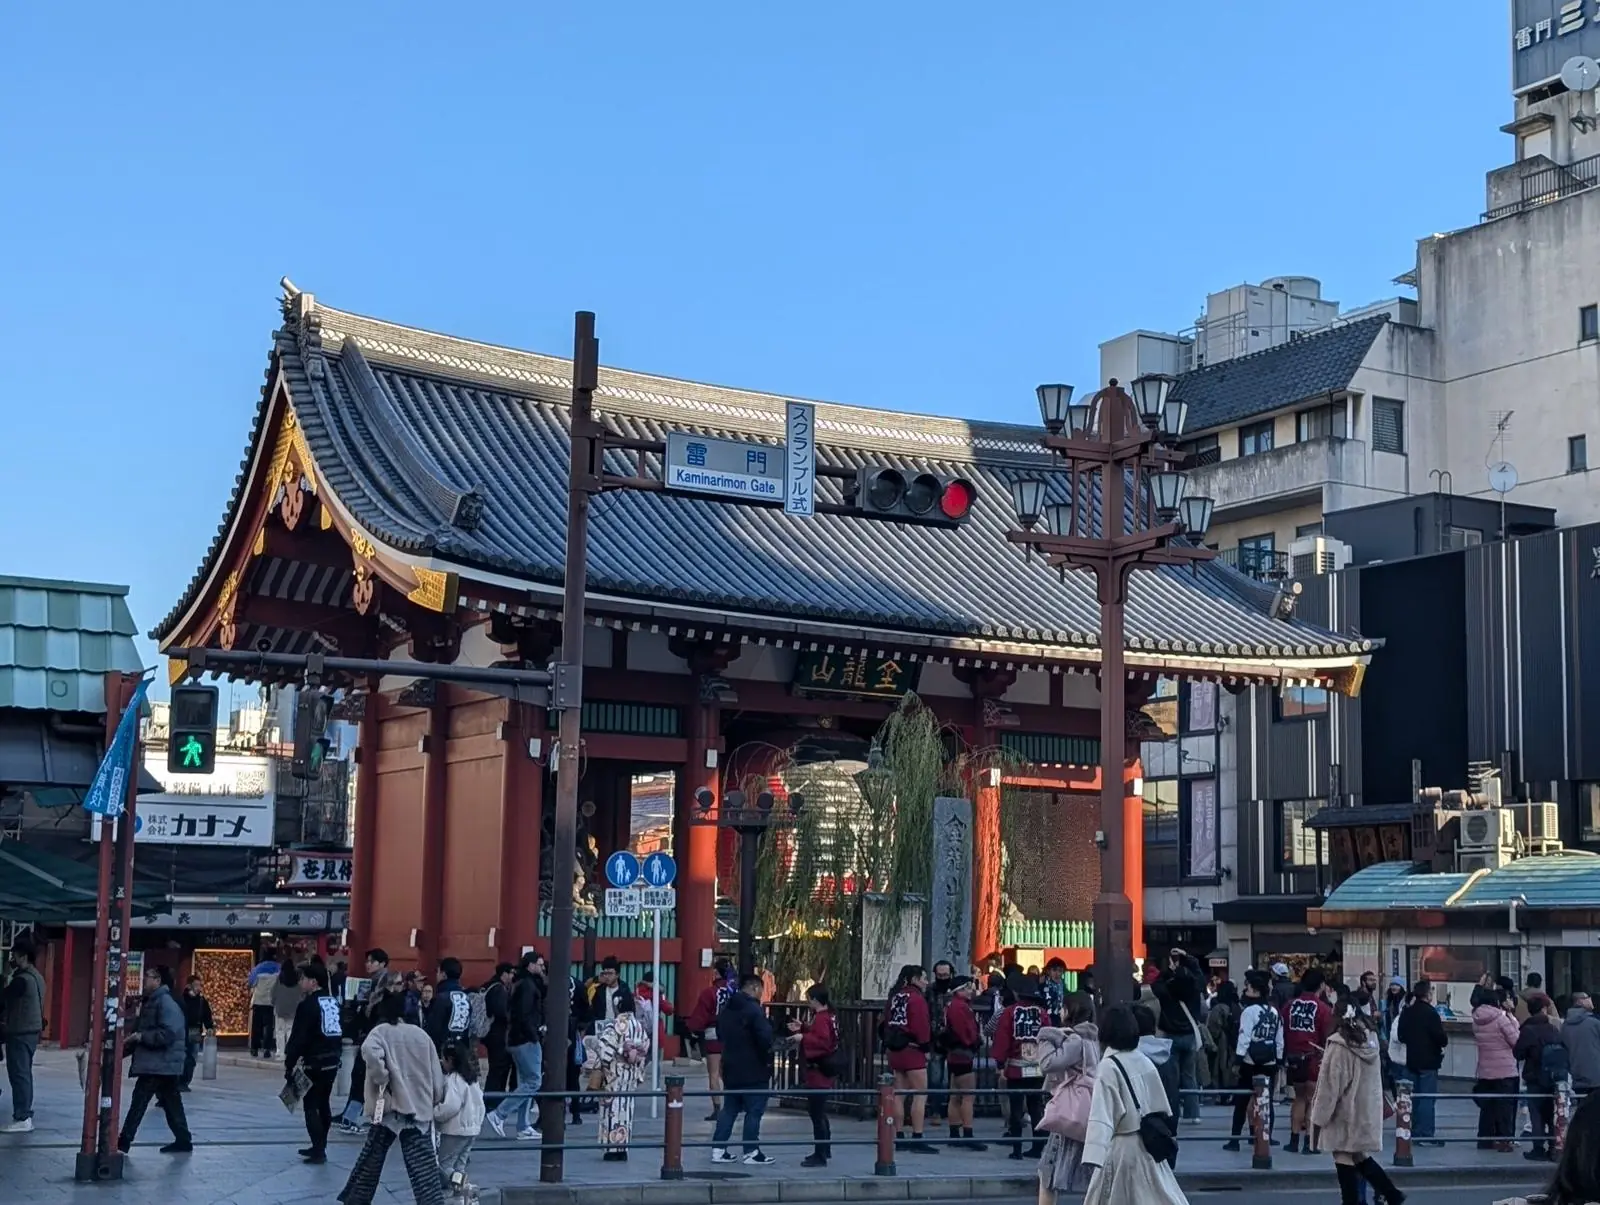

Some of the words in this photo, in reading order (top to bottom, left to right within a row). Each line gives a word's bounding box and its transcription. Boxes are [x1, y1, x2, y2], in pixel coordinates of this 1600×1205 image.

[1515, 18, 1552, 51] 雷門
[686, 442, 767, 475] 雷門
[792, 407, 809, 512] スクランブル式
[676, 469, 747, 491] Kaminarimon
[750, 479, 776, 494] Gate
[171, 813, 252, 838] カナメ
